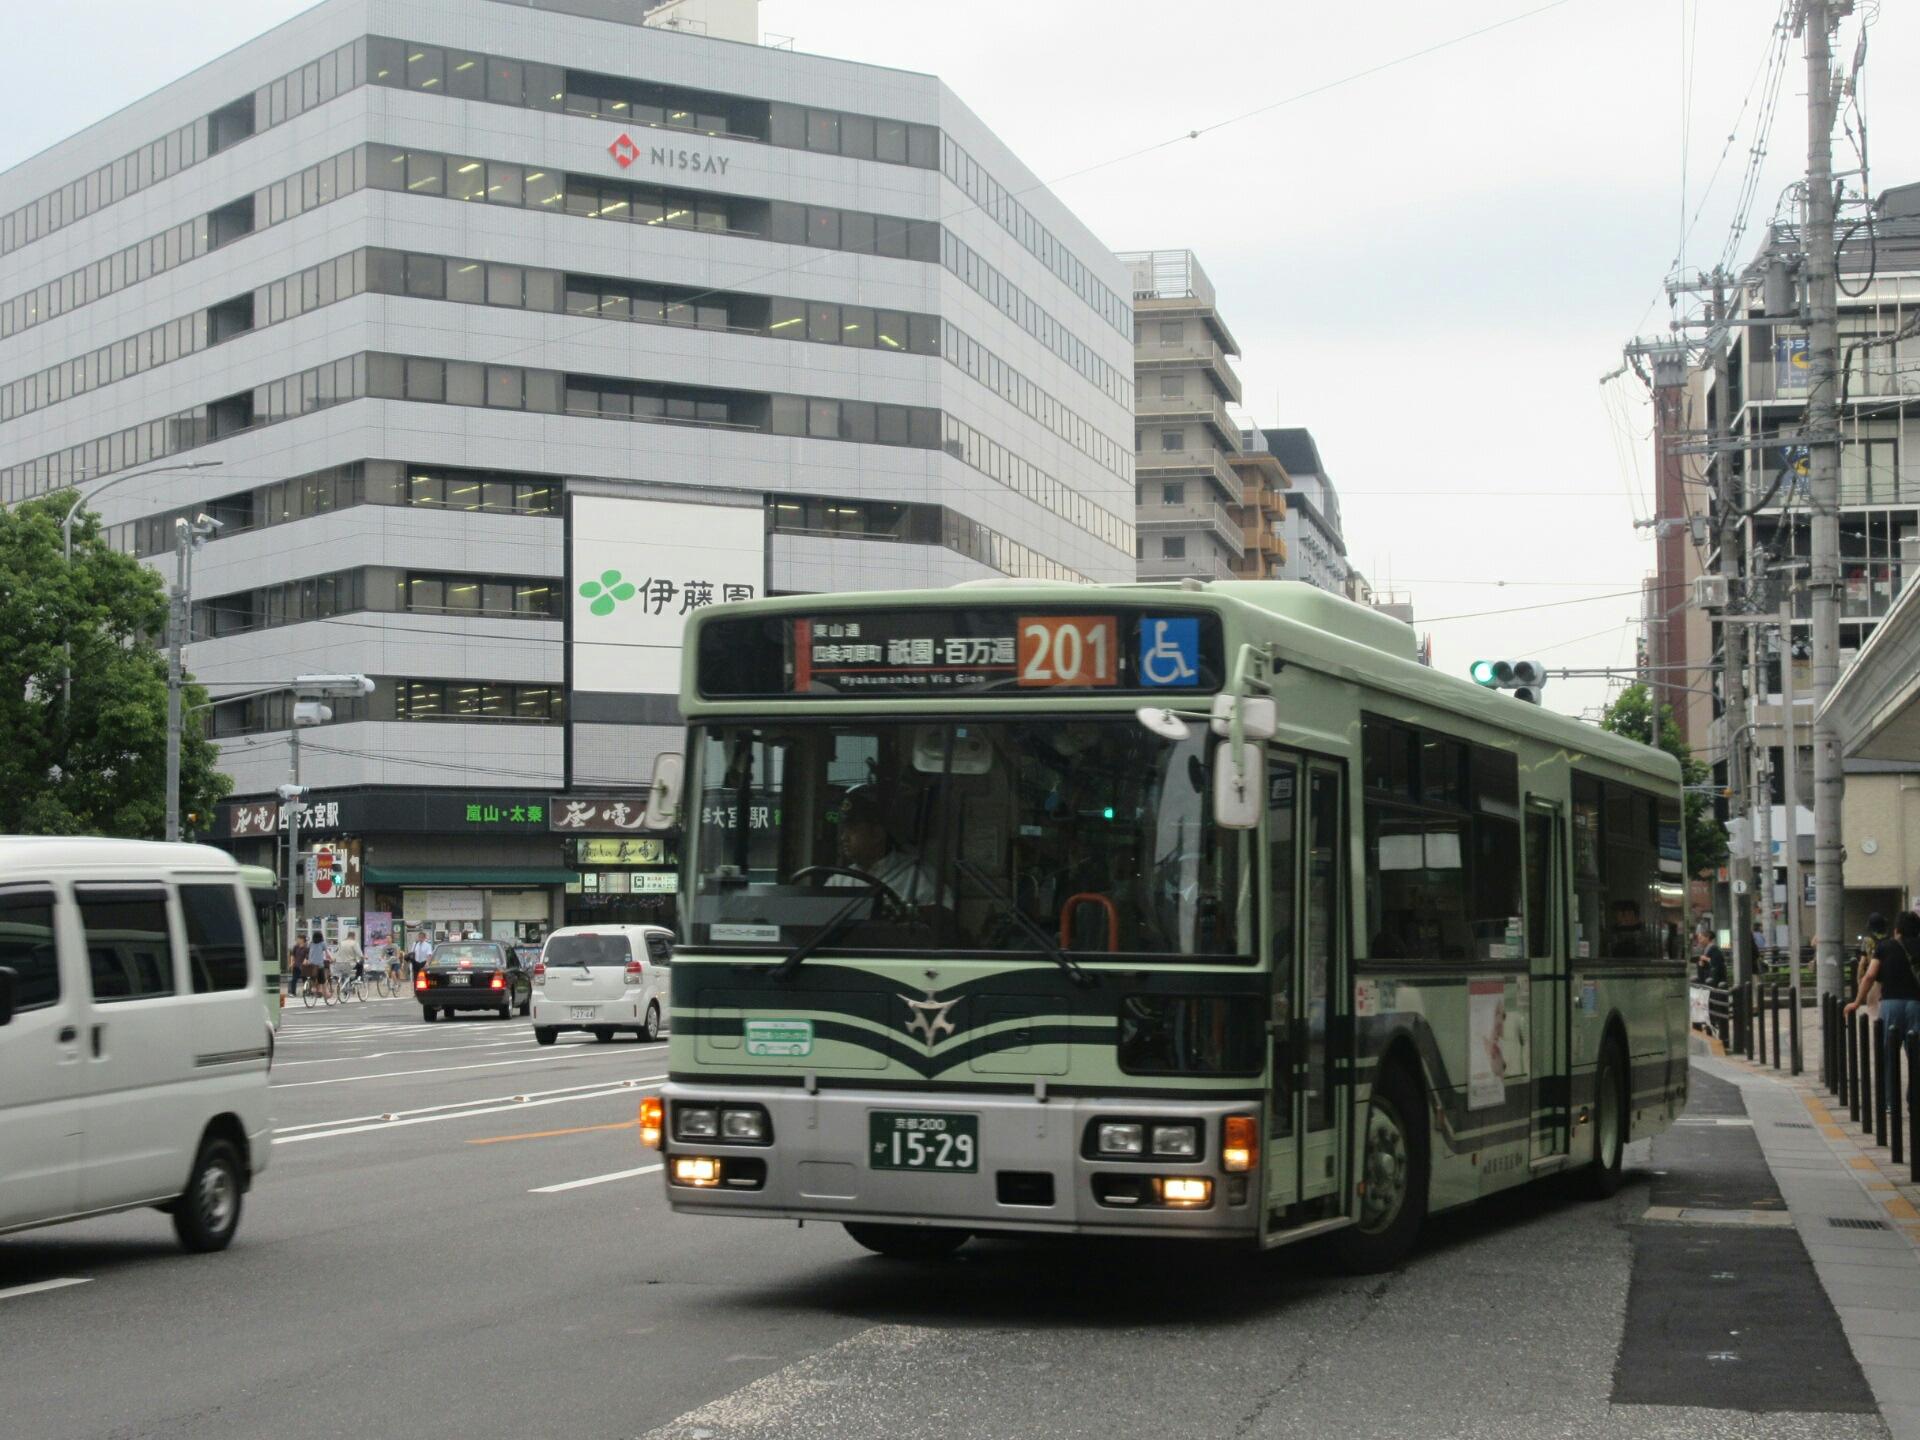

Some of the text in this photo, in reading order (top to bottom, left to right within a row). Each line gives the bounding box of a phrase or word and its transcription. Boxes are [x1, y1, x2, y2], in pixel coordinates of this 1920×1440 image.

[651, 147, 729, 175] NISSAY
[638, 577, 755, 615] 伊藤園
[813, 623, 861, 637] 東山通
[812, 644, 882, 662] 四条河原町
[1024, 624, 1106, 680] 201
[930, 674, 951, 684] Via
[955, 674, 985, 684] Gion
[466, 804, 543, 822] 嵐山・太秦
[345, 885, 360, 898] B1F
[892, 1131, 974, 1167] 15-29
